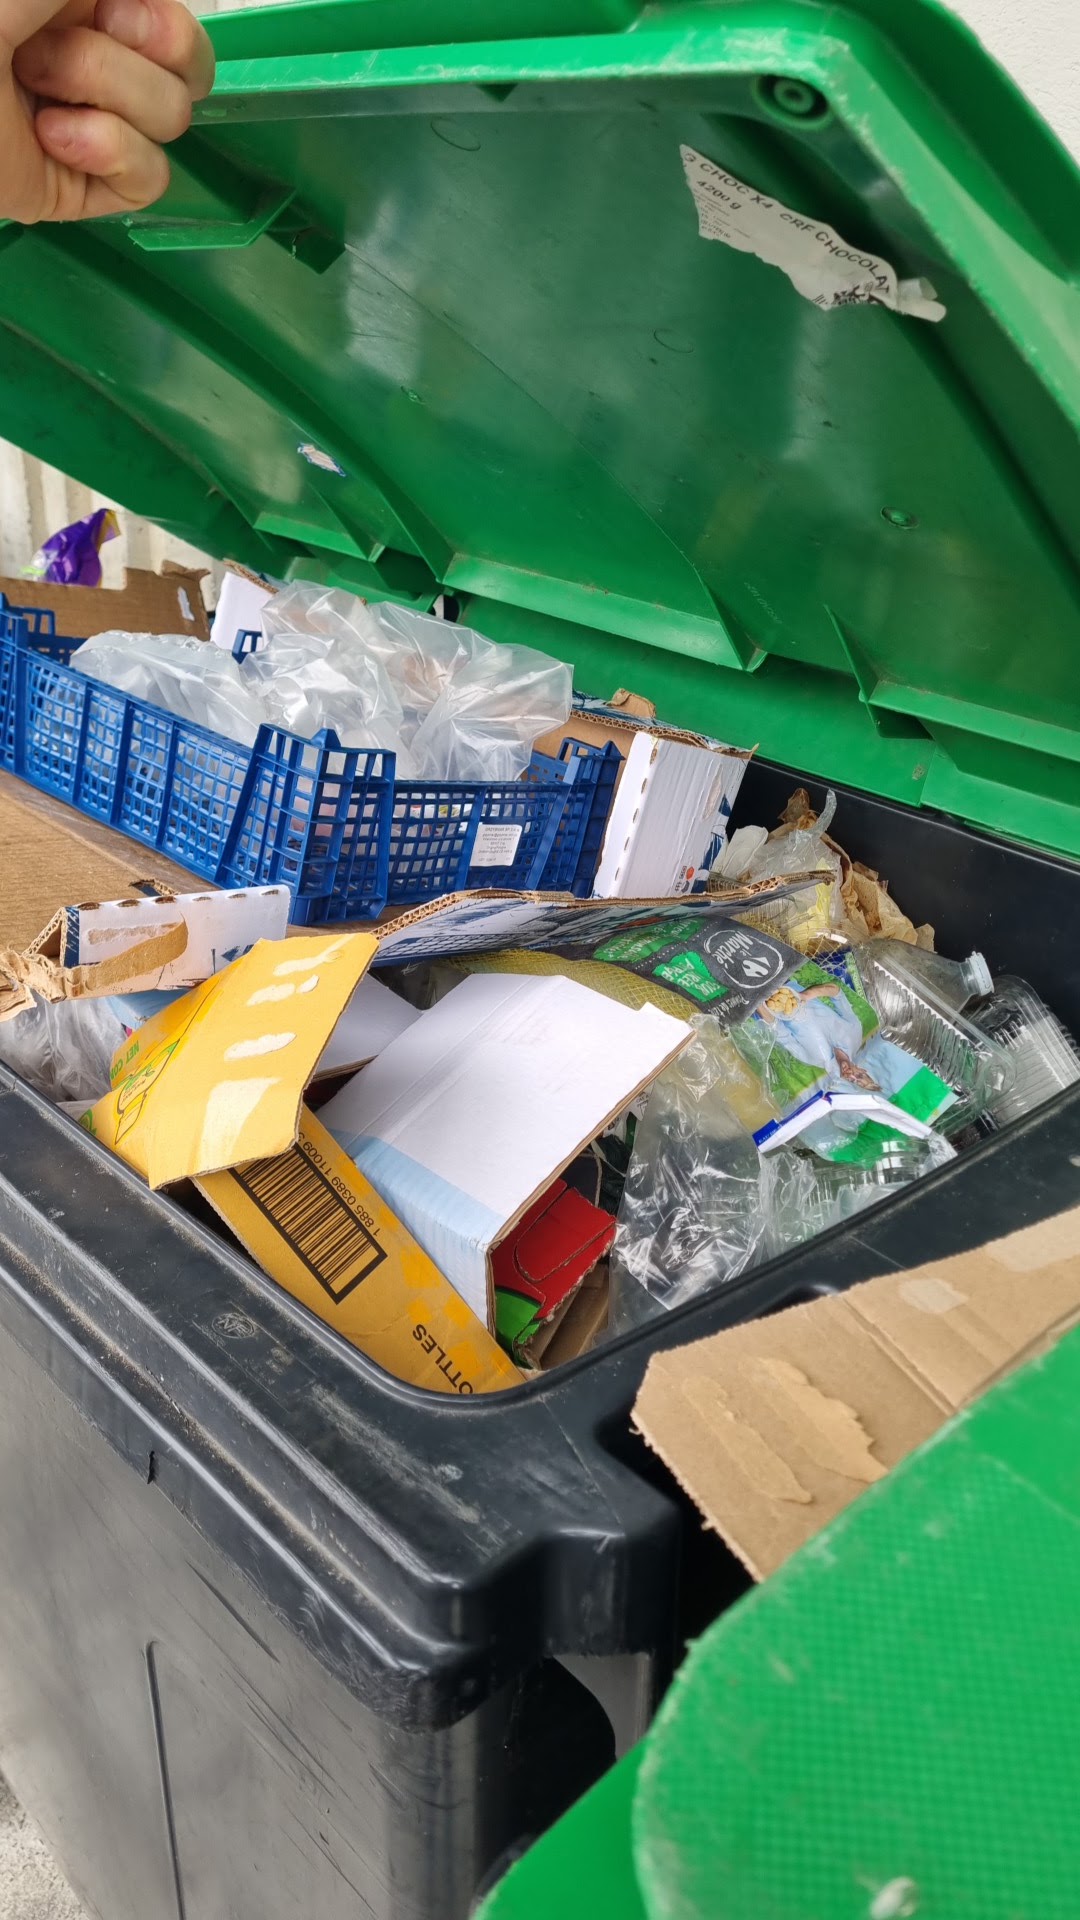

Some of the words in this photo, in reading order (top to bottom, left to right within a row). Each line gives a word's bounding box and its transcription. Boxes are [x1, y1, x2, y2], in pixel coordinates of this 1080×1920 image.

[697, 180, 731, 202] 4200
[729, 202, 742, 210] g
[700, 163, 750, 195] CHOC
[750, 194, 774, 209] X4
[780, 213, 816, 232] CRF
[815, 231, 891, 294] CHOCOLAT
[711, 930, 754, 969] Marché
[740, 948, 753, 957] le
[126, 1040, 140, 1065] NET
[302, 1141, 332, 1177] 11009
[331, 1176, 356, 1206] 0389
[354, 1204, 375, 1228] 885
[372, 1227, 381, 1237] 1
[412, 1323, 474, 1394] OTTLES
